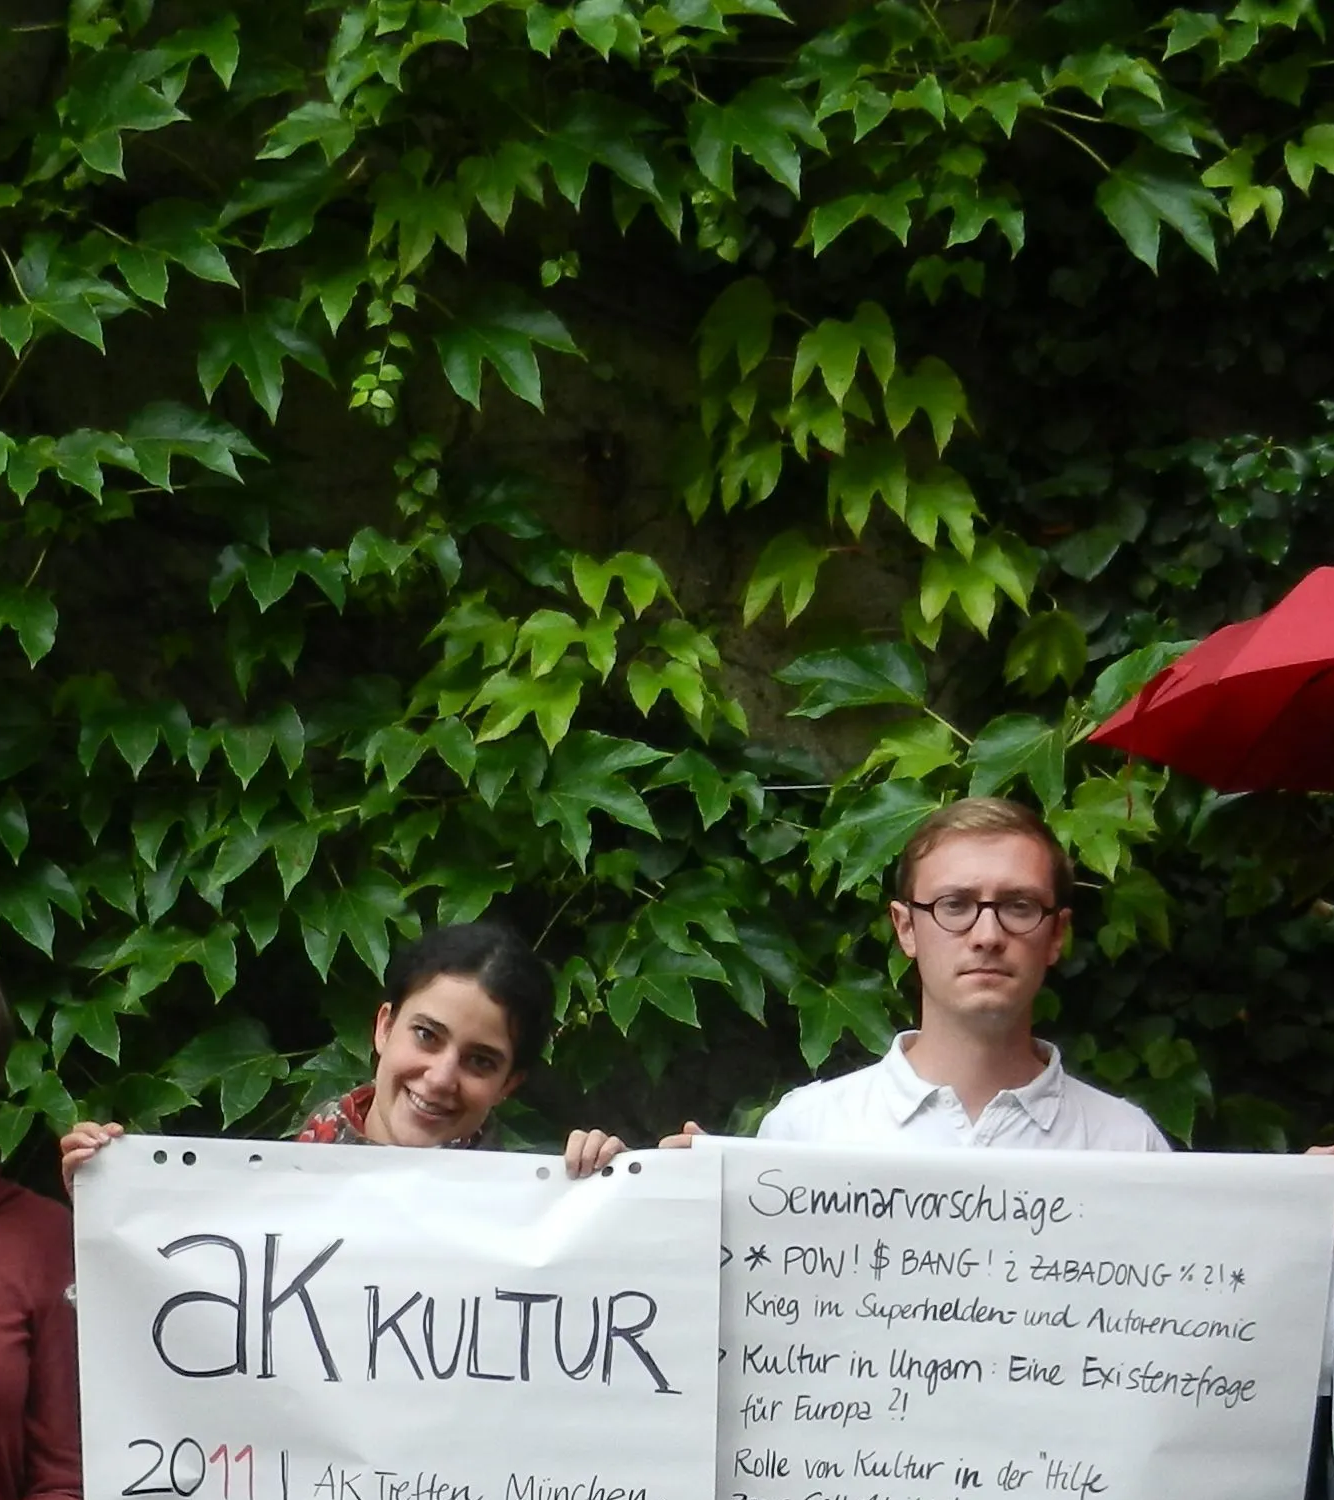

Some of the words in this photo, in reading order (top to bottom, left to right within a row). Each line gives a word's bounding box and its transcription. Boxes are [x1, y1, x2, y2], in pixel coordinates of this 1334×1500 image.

[365, 1285, 682, 1394] KULTUR
[745, 1291, 799, 1325] Krieg
[814, 1295, 843, 1317] im
[1023, 1304, 1080, 1328] und
[1087, 1307, 1256, 1342] Autorencomic
[742, 1344, 841, 1375] Kultur
[849, 1350, 878, 1378] in
[1008, 1356, 1065, 1385] Eine
[1082, 1356, 1257, 1408] Existenzfrage
[740, 1393, 783, 1429] für
[794, 1395, 872, 1427] Europa
[734, 1449, 790, 1479] Rolle
[804, 1458, 845, 1479] von
[853, 1449, 945, 1480] Kultur
[955, 1458, 983, 1489] in
[996, 1460, 1033, 1491] der
